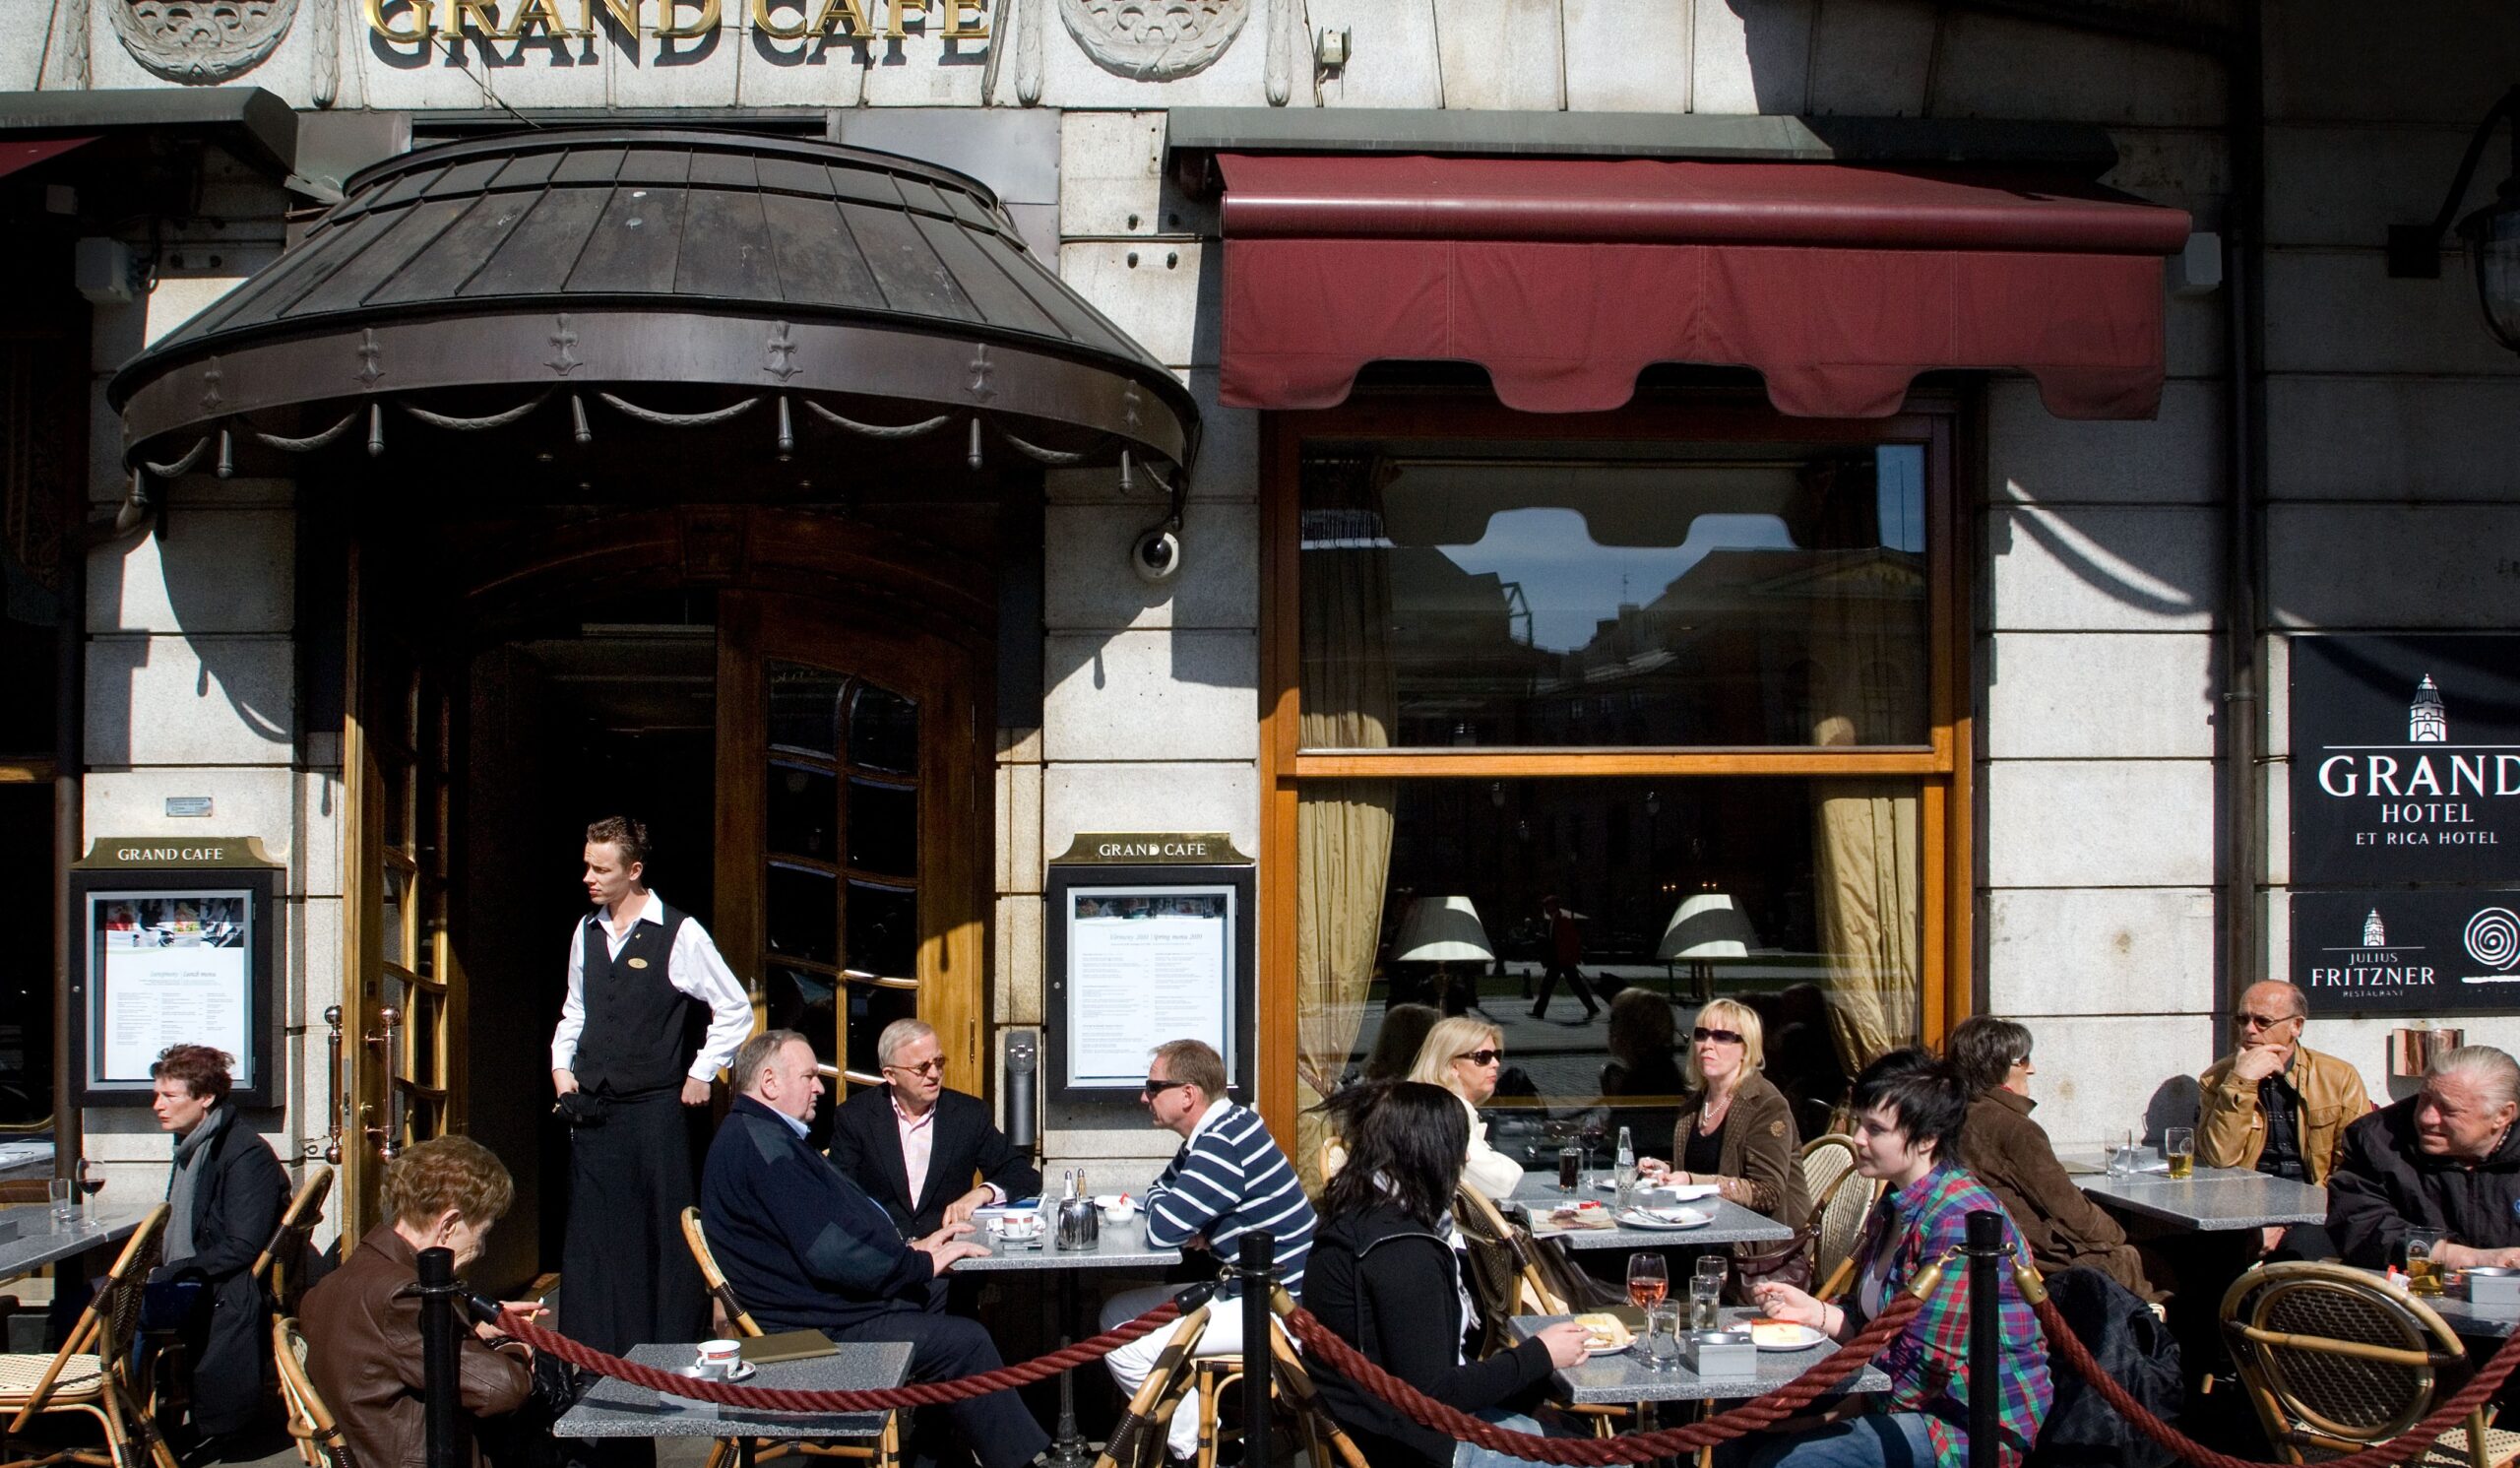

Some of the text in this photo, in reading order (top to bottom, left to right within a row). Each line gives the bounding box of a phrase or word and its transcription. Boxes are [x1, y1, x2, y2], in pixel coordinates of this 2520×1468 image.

[363, 0, 722, 43] GRAND
[2318, 755, 2520, 798] GRAND
[2381, 803, 2475, 823] HOTEL
[2356, 831, 2498, 846] ET RICA HOTEL
[118, 848, 223, 861] GRAND CAFE
[1099, 843, 1206, 857] GRAND CAFE
[2349, 952, 2399, 965] JULIUS
[2311, 966, 2435, 987] FRITZNER
